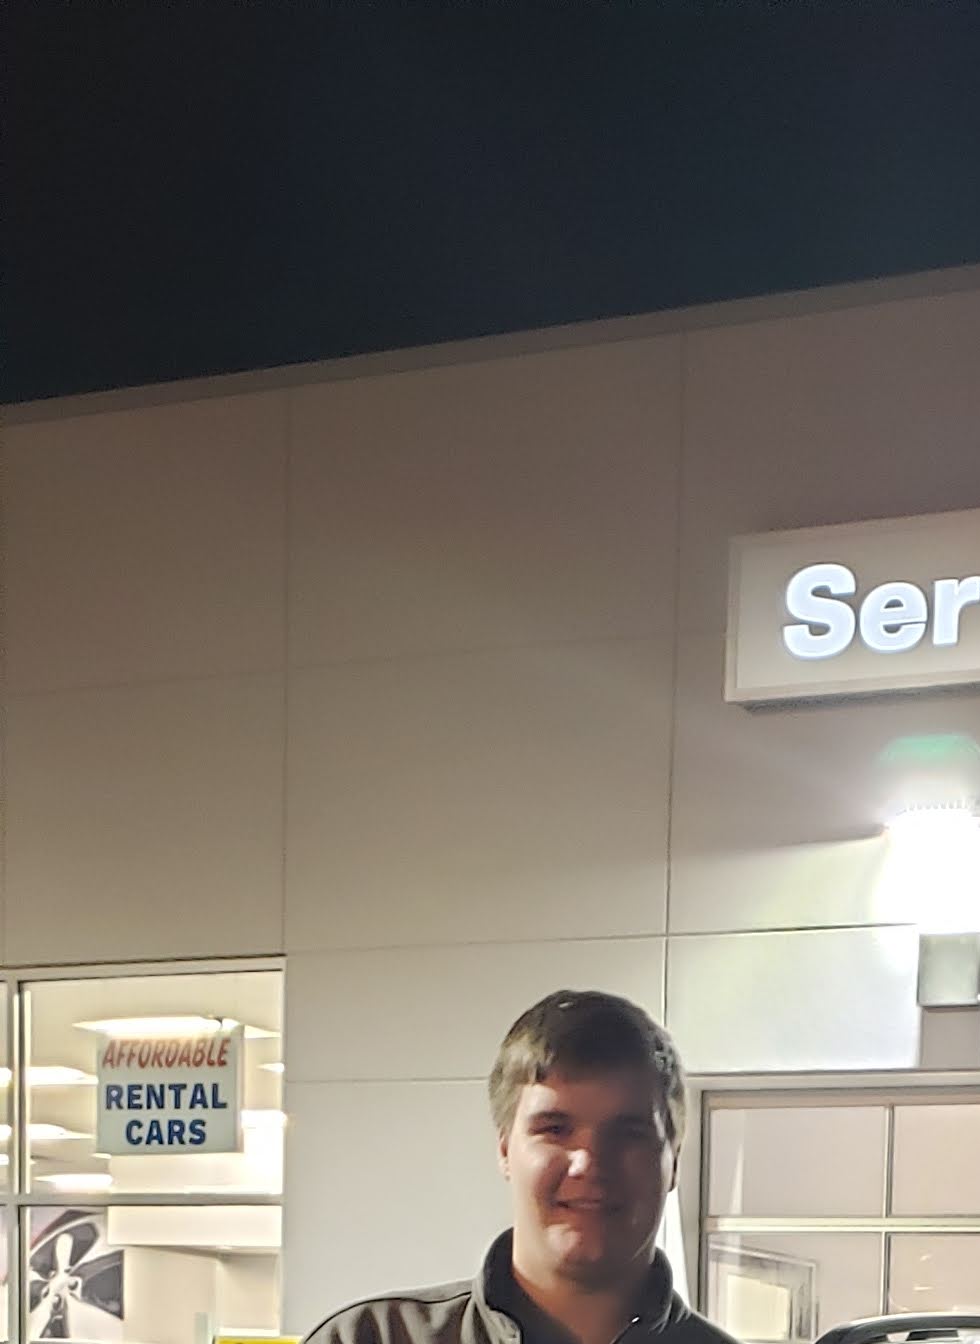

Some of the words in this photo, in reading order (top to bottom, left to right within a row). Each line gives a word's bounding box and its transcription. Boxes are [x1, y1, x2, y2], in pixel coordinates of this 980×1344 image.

[102, 1038, 231, 1069] AFFORDABLE
[105, 1083, 228, 1110] RENTAL
[126, 1119, 207, 1146] CARS
